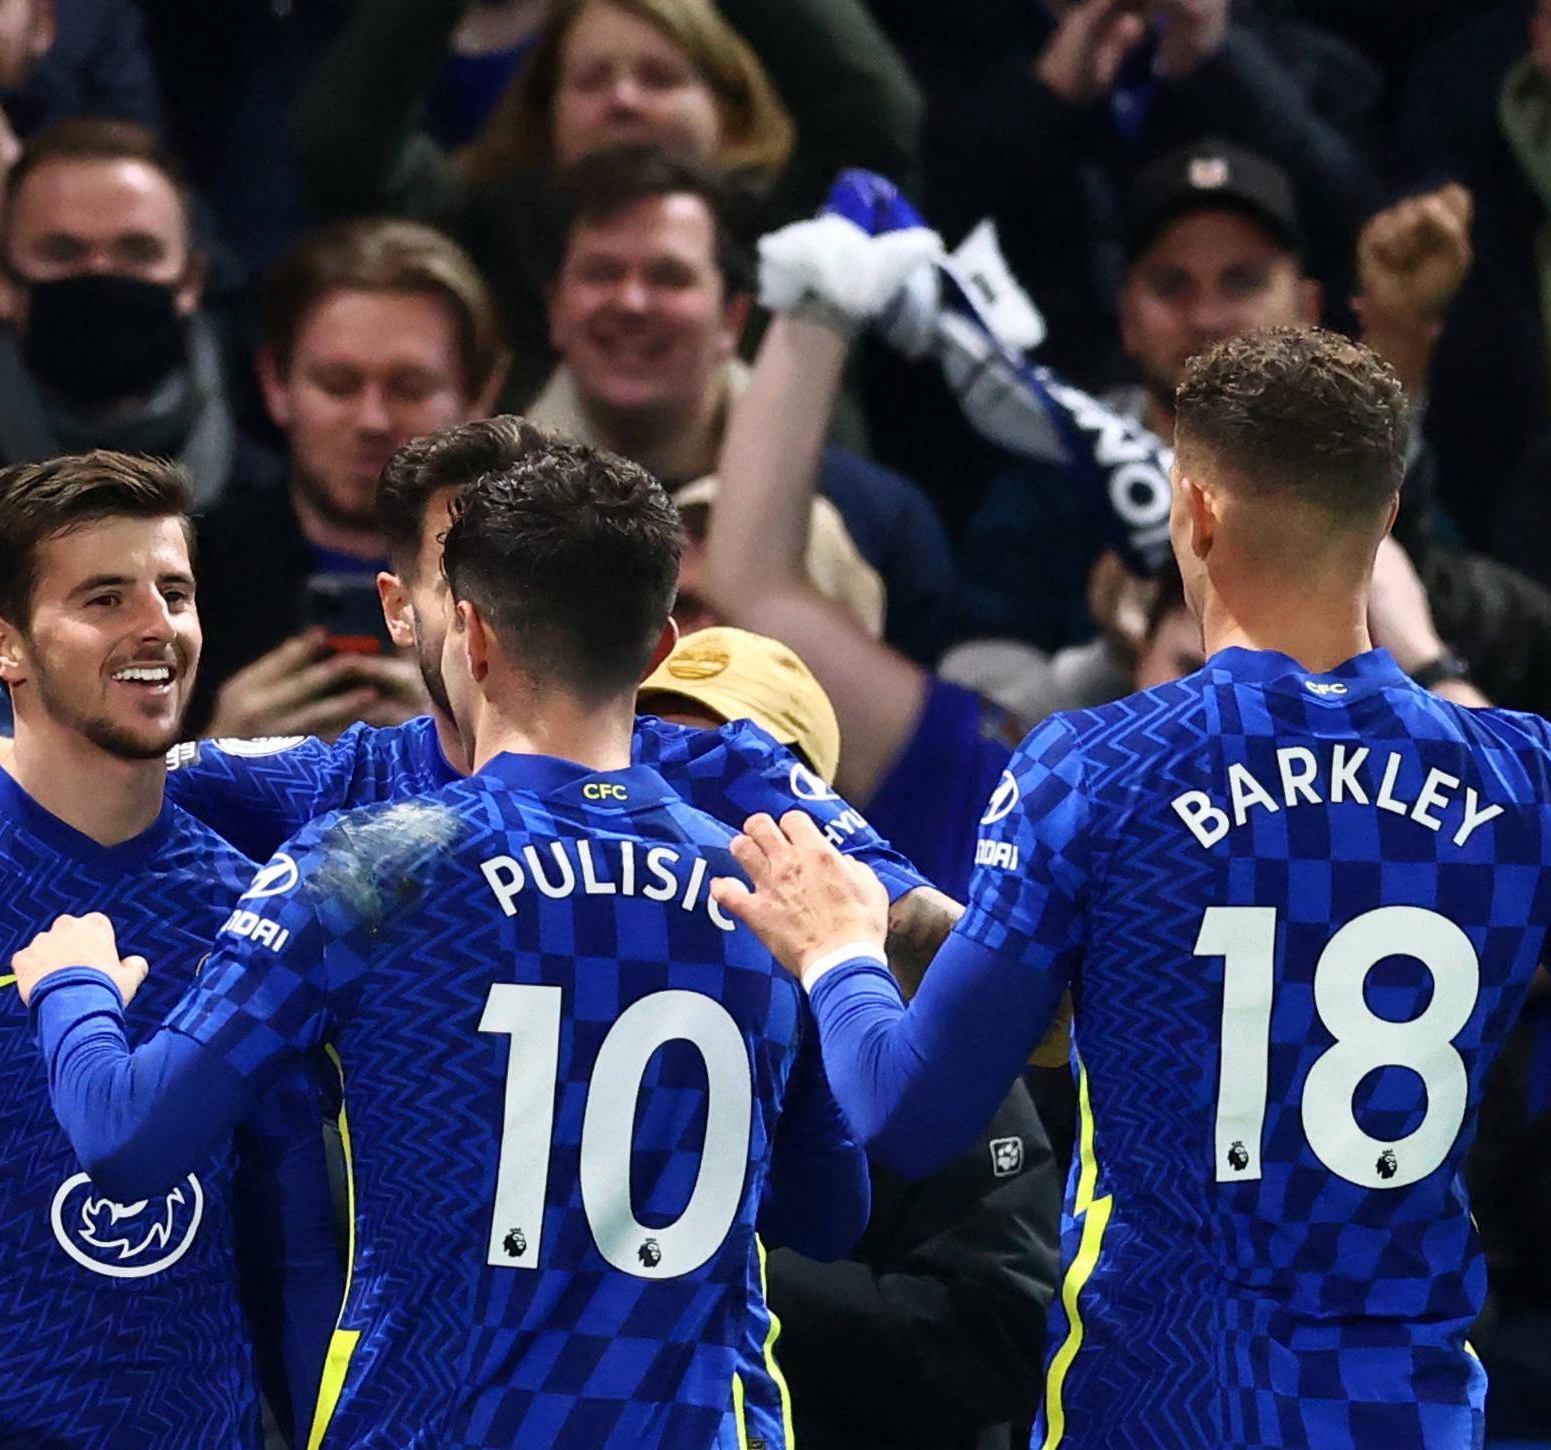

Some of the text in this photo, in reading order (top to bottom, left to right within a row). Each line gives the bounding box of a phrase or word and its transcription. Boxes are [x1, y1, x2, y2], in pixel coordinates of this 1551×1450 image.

[1305, 681, 1348, 695] CFC
[582, 783, 628, 800] CFC
[1170, 744, 1505, 848] BARKLEY
[1192, 904, 1481, 1190] 18
[477, 983, 753, 1280] 10
